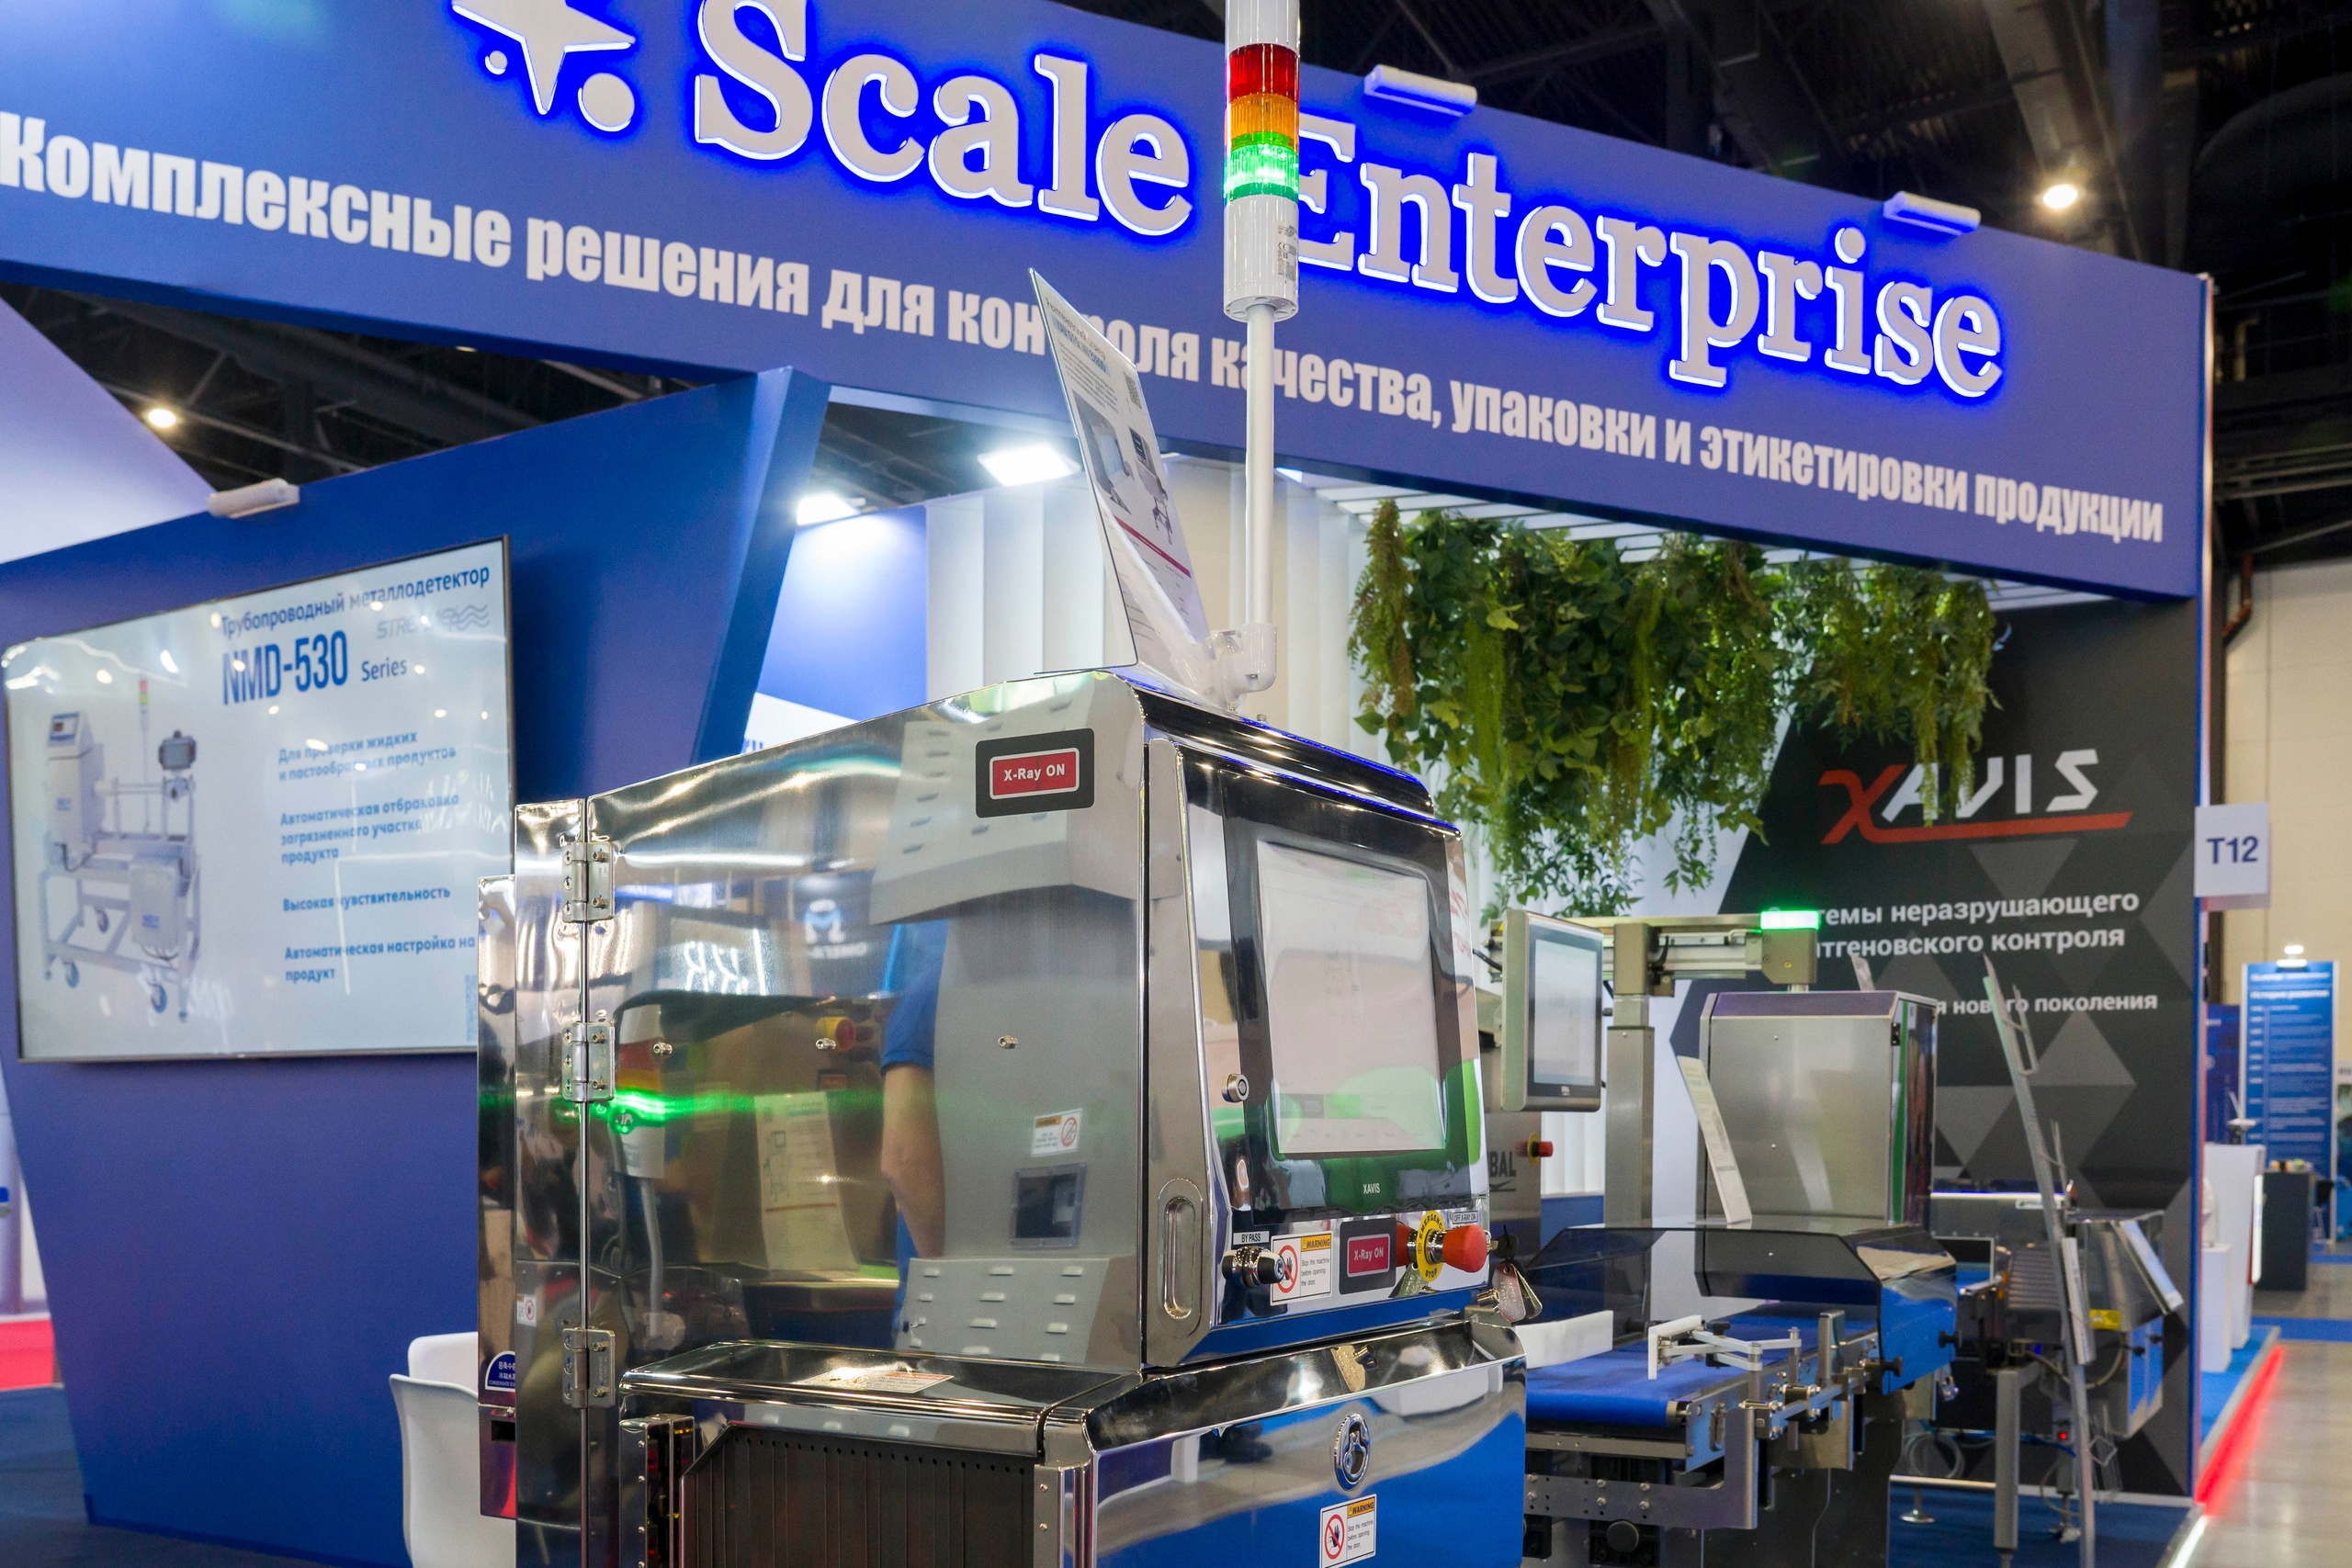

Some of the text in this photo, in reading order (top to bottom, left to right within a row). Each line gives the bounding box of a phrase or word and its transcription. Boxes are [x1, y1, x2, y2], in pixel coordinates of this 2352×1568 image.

[695, 0, 2003, 397] Scale Enterprise
[0, 111, 512, 267] Комплексные
[526, 216, 810, 316] решения
[822, 268, 934, 337] для
[948, 289, 1199, 382] коноля
[1211, 336, 1442, 429] кчества,
[1451, 379, 1656, 460] упаковки
[1665, 419, 1691, 466] и
[1699, 425, 1969, 513] этикетировки
[1975, 473, 2163, 543] продукции
[221, 566, 490, 639] Трубопроводный металлодетектор
[222, 630, 348, 705] NMD-530
[361, 659, 407, 682] Series
[278, 749, 301, 764] Для
[368, 732, 417, 750] жидких
[279, 771, 286, 781] и
[387, 747, 457, 769] продуктов
[1003, 763, 1065, 782] X-Ray ON
[1818, 749, 2100, 845] XAVIS
[281, 847, 339, 865] продукта
[2206, 836, 2258, 864] T12
[283, 897, 334, 912] Высокая
[1891, 892, 2140, 927] неразрушающего
[387, 935, 456, 954] настройка
[459, 937, 475, 948] на
[1992, 928, 2125, 953] контроля
[286, 968, 335, 984] продукт
[1953, 998, 2029, 1015] новго
[2035, 994, 2158, 1011] поколения
[1363, 1183, 1381, 1194] XAVIS
[1419, 1213, 1443, 1239] EMERGENC
[1241, 1233, 1261, 1243] BY PASS
[1306, 1238, 1330, 1248] WARNING
[1317, 1258, 1329, 1266] machine
[1353, 1247, 1384, 1262] X-Ray ON
[1301, 1267, 1326, 1277] before opening
[1425, 1268, 1437, 1279] STOP
[1352, 1501, 1374, 1514] WARNING
